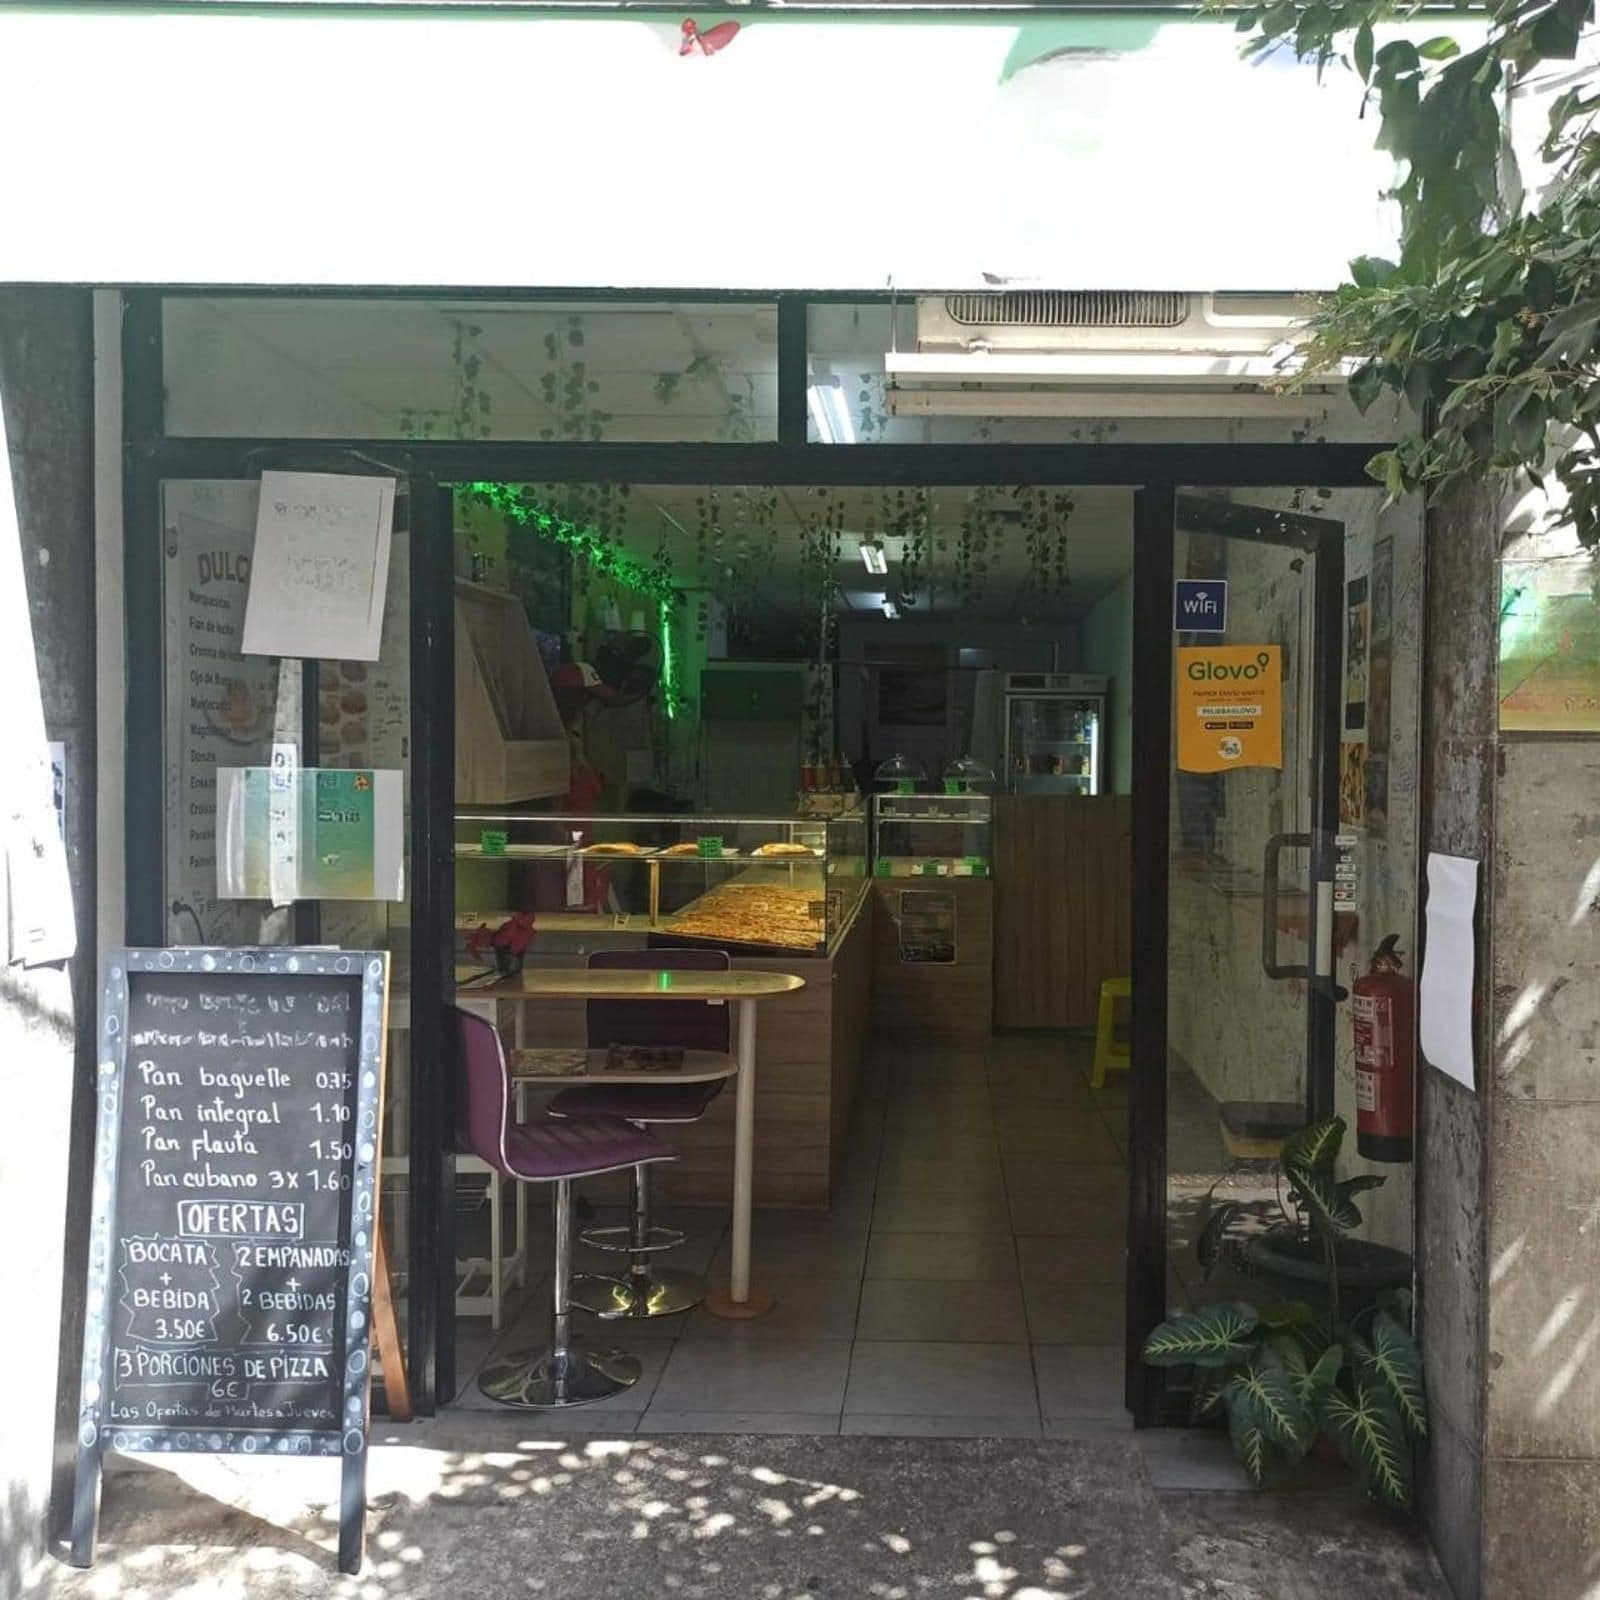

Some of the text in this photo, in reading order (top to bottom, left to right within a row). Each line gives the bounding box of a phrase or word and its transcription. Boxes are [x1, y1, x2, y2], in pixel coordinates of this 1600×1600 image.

[1188, 660, 1259, 681] Glovo
[138, 1060, 183, 1086] Pan
[140, 1094, 351, 1135] Pan integral 1.10
[141, 1127, 181, 1151] Pan
[309, 1139, 352, 1160] 1.50
[140, 1160, 177, 1187] Pan
[183, 1163, 258, 1188] cubano
[306, 1171, 349, 1191] 1.60
[187, 1203, 298, 1233] OFERTAS
[128, 1241, 207, 1265] BOCATA
[239, 1247, 350, 1268] 2 EMPANADAS
[242, 1290, 252, 1306] 2
[154, 1318, 205, 1339] 3.50€
[266, 1324, 323, 1343] 6.50€
[118, 1353, 132, 1377] 3
[137, 1354, 236, 1377] PORCIONES
[245, 1358, 265, 1378] DE
[211, 1381, 239, 1399] 6€
[110, 1401, 139, 1419] Las
